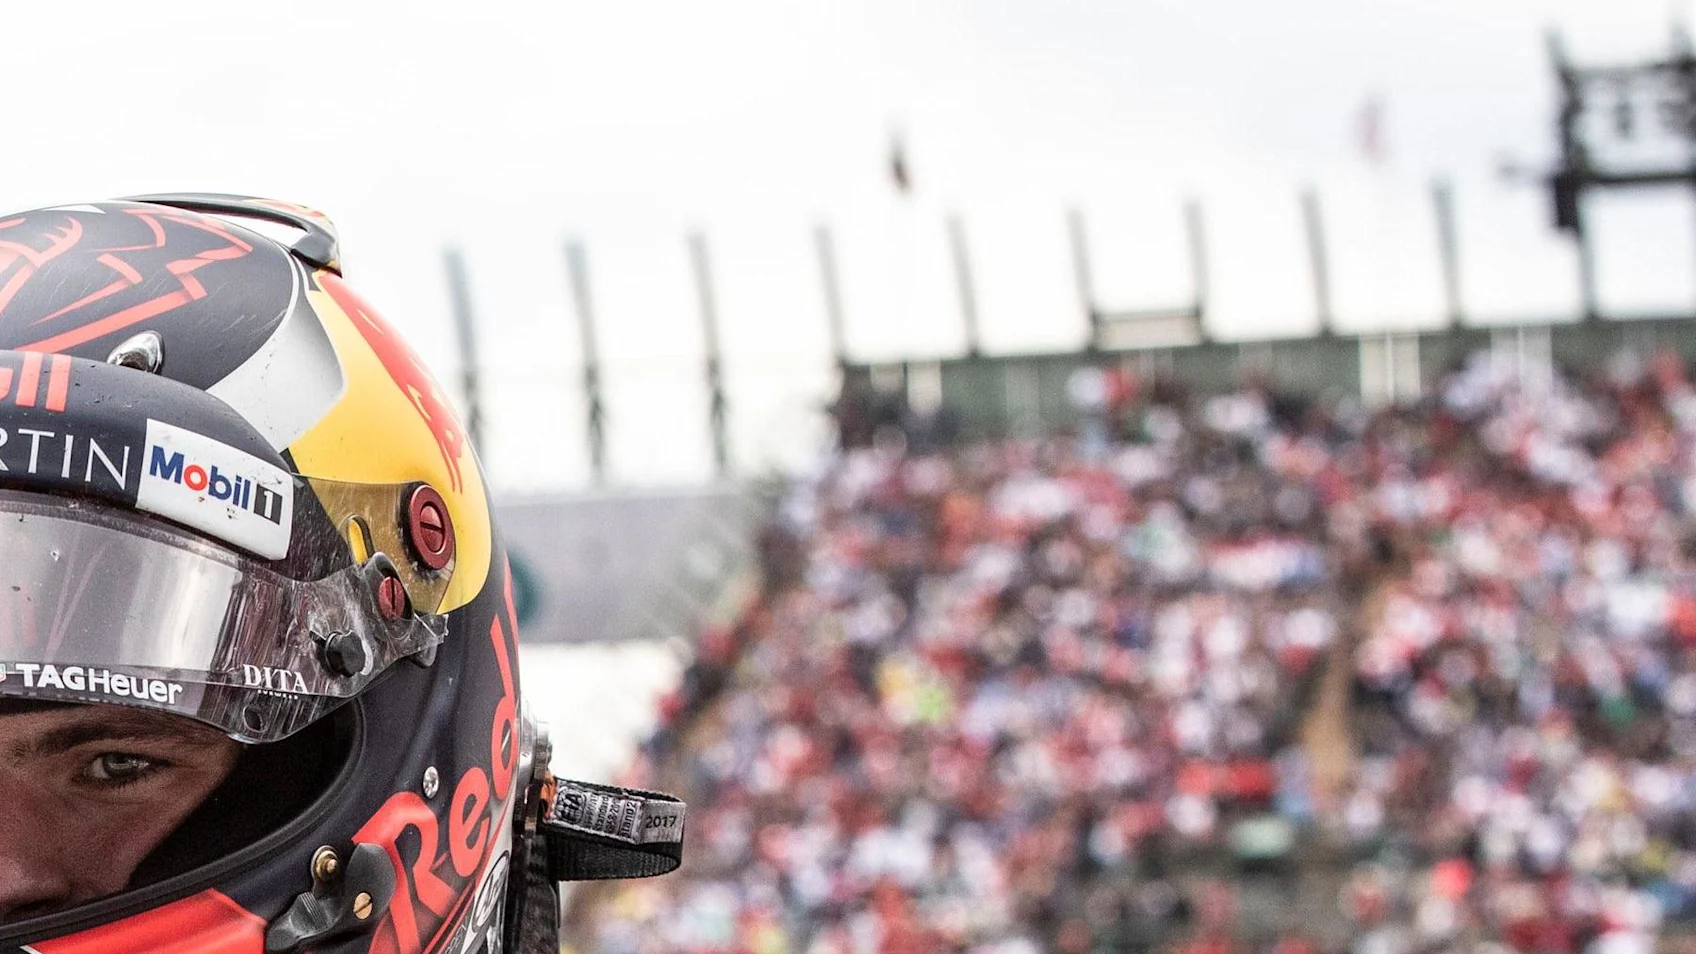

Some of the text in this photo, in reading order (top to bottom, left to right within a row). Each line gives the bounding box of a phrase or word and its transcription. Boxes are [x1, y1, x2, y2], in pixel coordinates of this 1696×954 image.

[149, 445, 250, 511] Mobil
[243, 664, 309, 695] DITA
[645, 816, 677, 829] 2017
